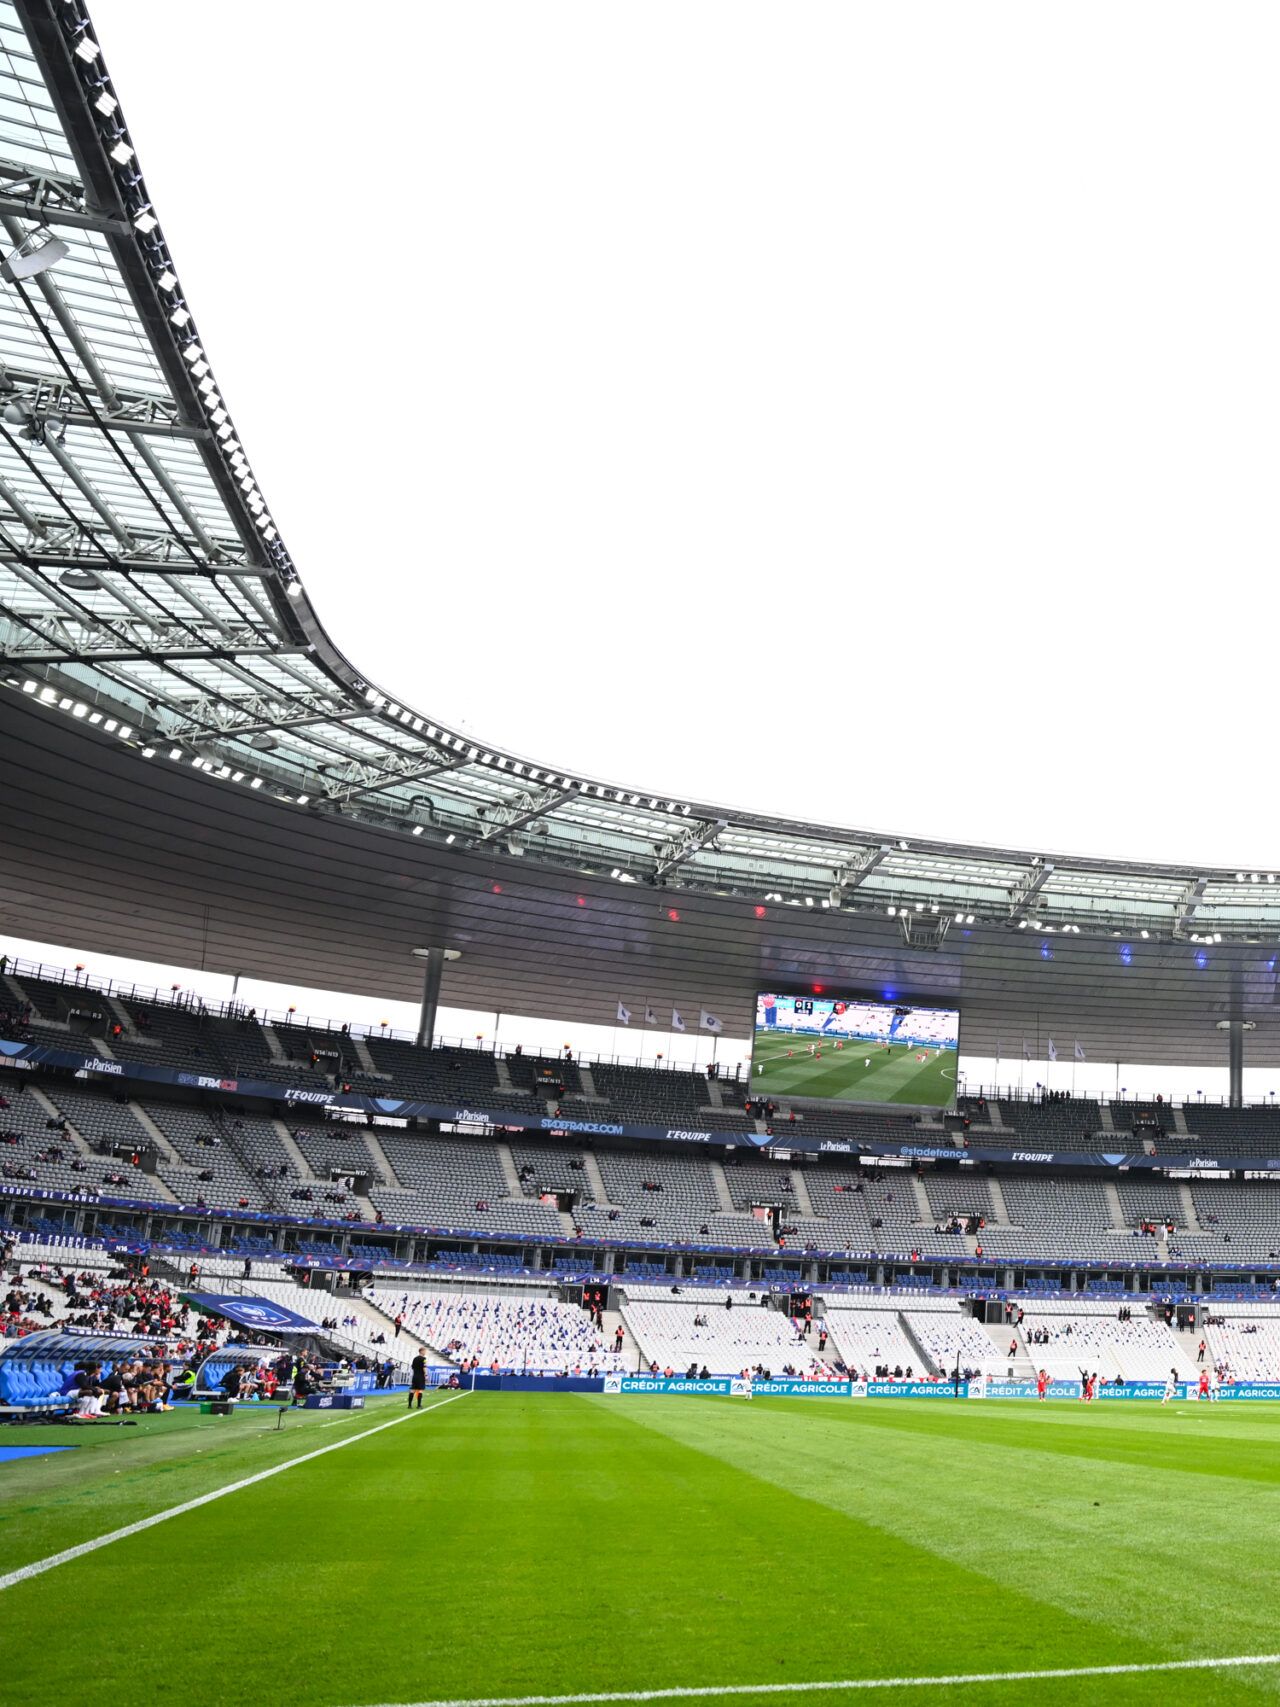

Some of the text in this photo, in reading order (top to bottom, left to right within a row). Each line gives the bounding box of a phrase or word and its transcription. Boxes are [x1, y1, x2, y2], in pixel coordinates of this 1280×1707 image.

[85, 1058, 122, 1074] Le Parisien
[178, 1073, 238, 1091] STADEFRANCE
[455, 1110, 489, 1122] Le Parisien
[541, 1118, 623, 1135] STADEFRANCE.COM
[827, 1141, 850, 1152] Parisien
[900, 1146, 968, 1159] @stadefrance
[1196, 1158, 1218, 1167] Parisien
[2, 1187, 34, 1196] COUPE
[62, 1194, 100, 1203] FRANCE
[48, 1235, 87, 1249] FRANCE
[622, 1378, 727, 1391] CRÉDIT AGRICOLE
[751, 1382, 848, 1393] CRÉDIT AGRICOLE
[868, 1385, 908, 1394] CRÉDIT
[985, 1386, 1022, 1395] CRÉDIT
